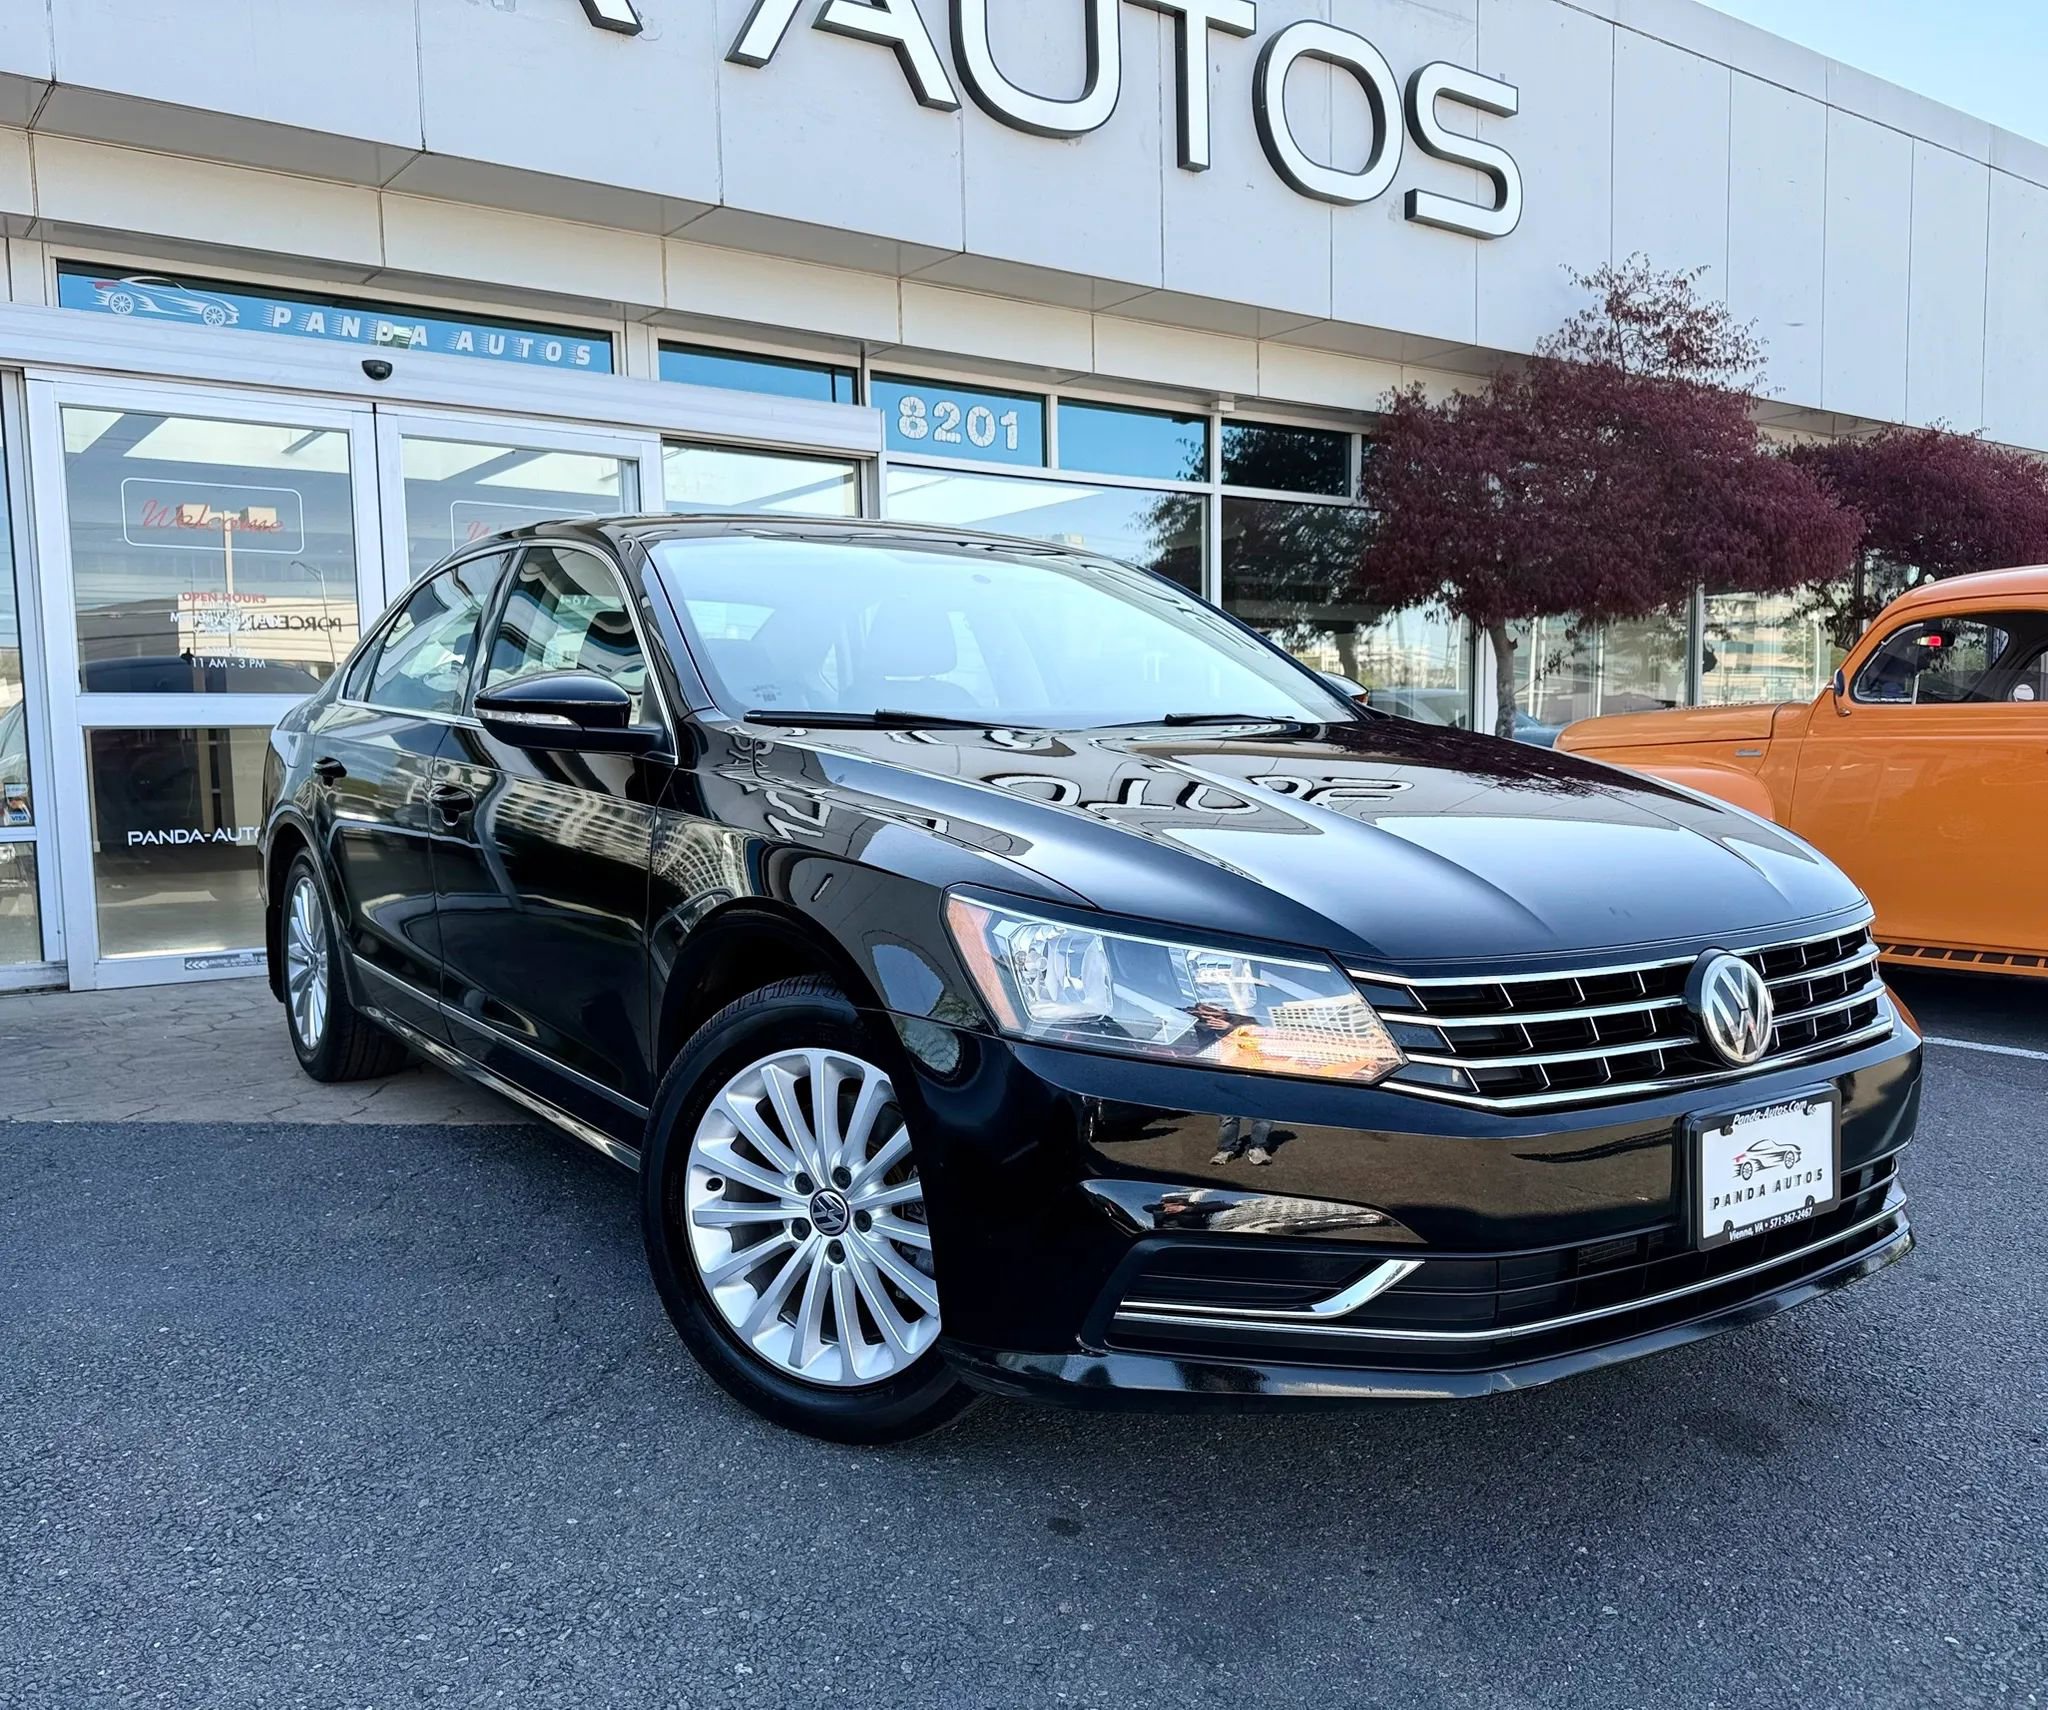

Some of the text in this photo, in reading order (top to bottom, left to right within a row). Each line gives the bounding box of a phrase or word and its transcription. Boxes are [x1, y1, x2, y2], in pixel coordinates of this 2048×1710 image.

[268, 304, 591, 366] PANDA AUTOS
[897, 396, 1019, 450] 8201
[142, 499, 284, 531] Welcome
[182, 591, 267, 604] OPEN HOURS
[191, 657, 204, 669] 11
[208, 658, 228, 669] AM
[238, 658, 246, 669] 3
[249, 658, 267, 669] PM
[1711, 1168, 1823, 1210] PANDA AUTOS
[1754, 1222, 1764, 1233] VA
